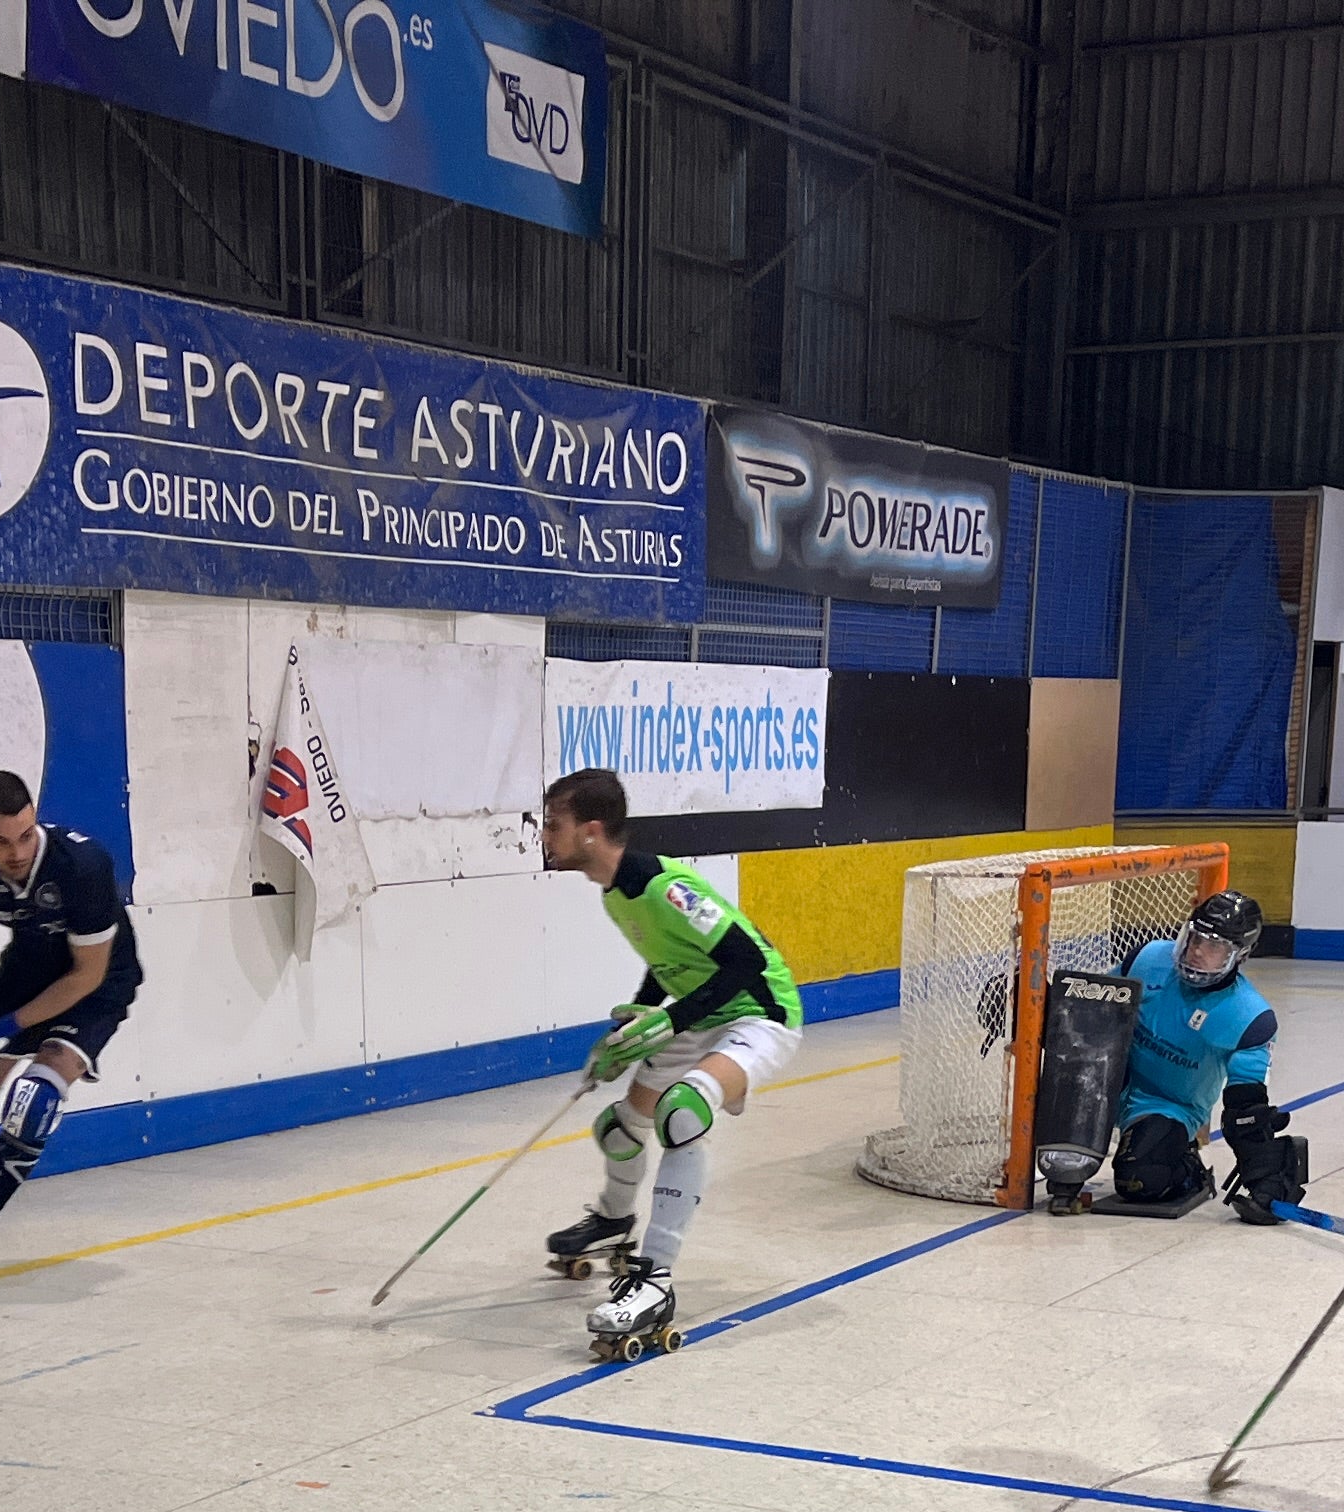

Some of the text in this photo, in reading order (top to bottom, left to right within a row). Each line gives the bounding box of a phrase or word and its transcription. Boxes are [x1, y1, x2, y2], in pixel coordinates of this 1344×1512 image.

[73, 332, 688, 496] DEPORTE ASTURIANO
[73, 449, 682, 569] GOBIERNO DEL PRINCIPADO DE ASTURIAS
[818, 486, 986, 557] POWERADE
[307, 735, 346, 823] OVIEDO
[557, 680, 818, 794] www.index-sports.es
[1061, 976, 1132, 1004] Reno
[614, 1310, 632, 1323] 22
